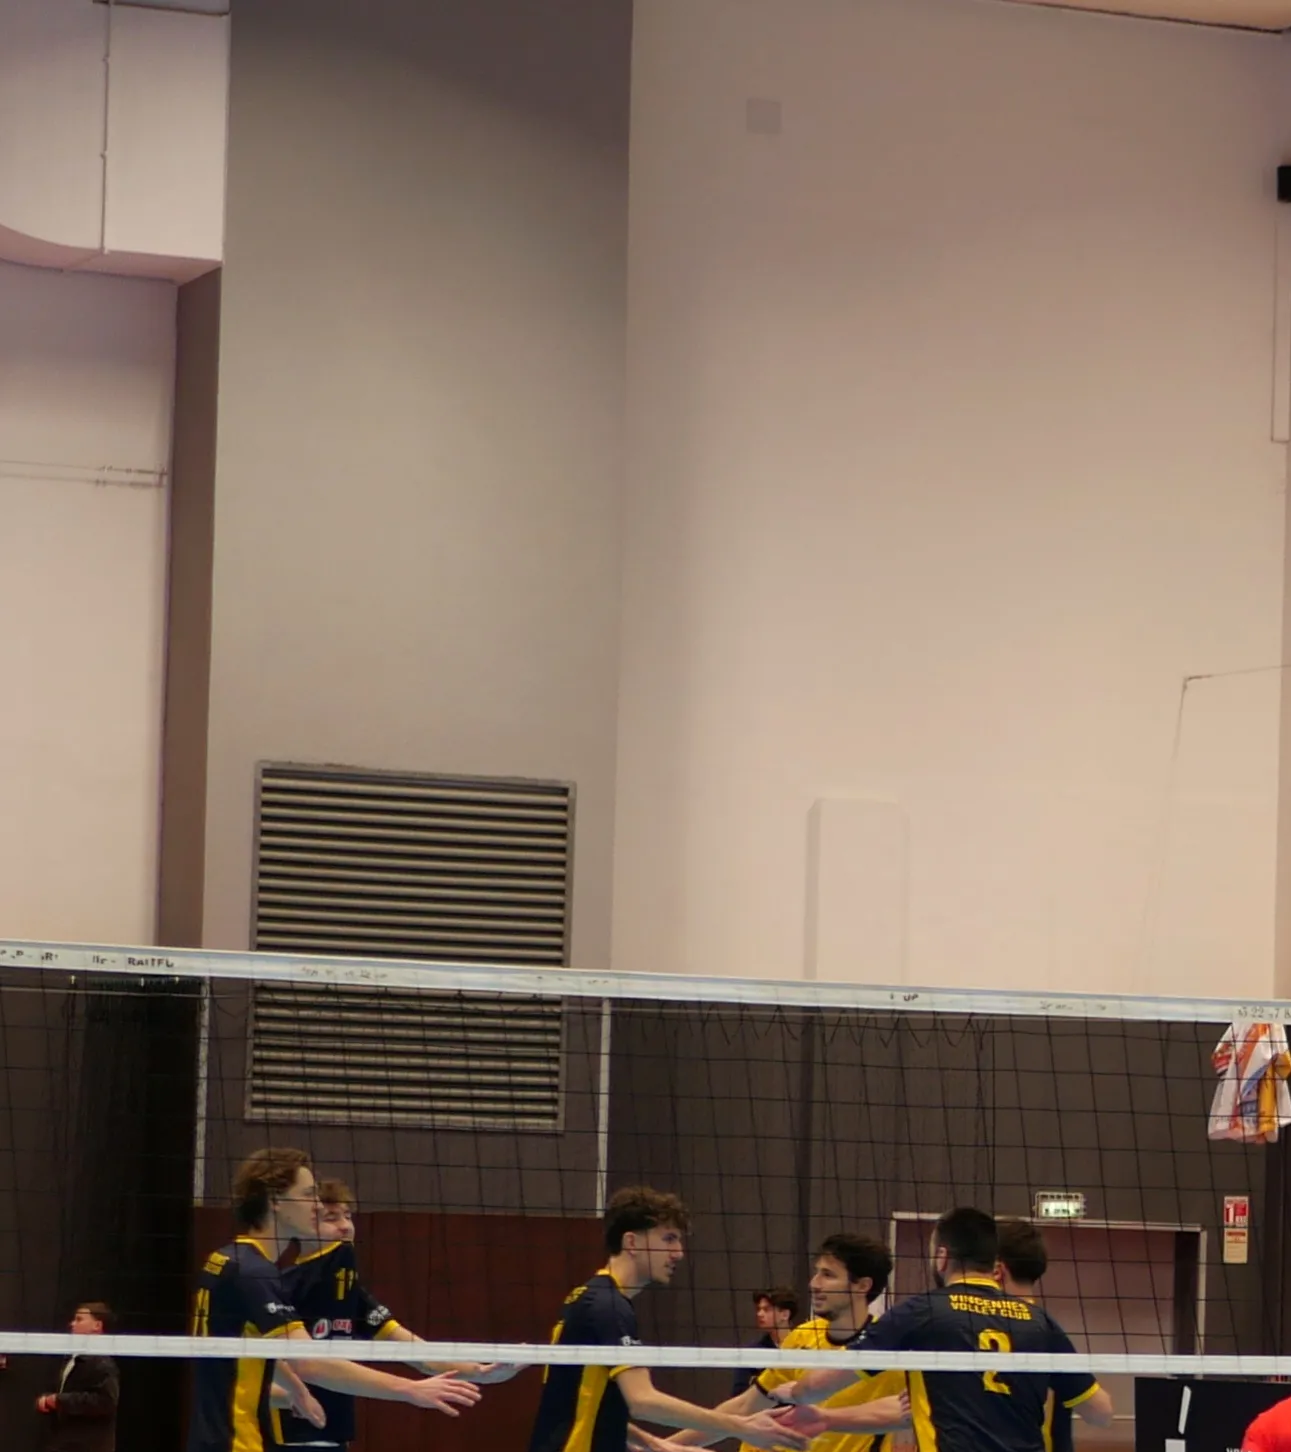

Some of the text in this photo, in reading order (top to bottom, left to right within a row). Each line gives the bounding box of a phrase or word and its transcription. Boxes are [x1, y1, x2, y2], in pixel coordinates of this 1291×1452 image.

[949, 1294, 1029, 1313] VINCENNES
[951, 1302, 1032, 1321] VOLLEY CLUB
[979, 1328, 1011, 1396] 2
